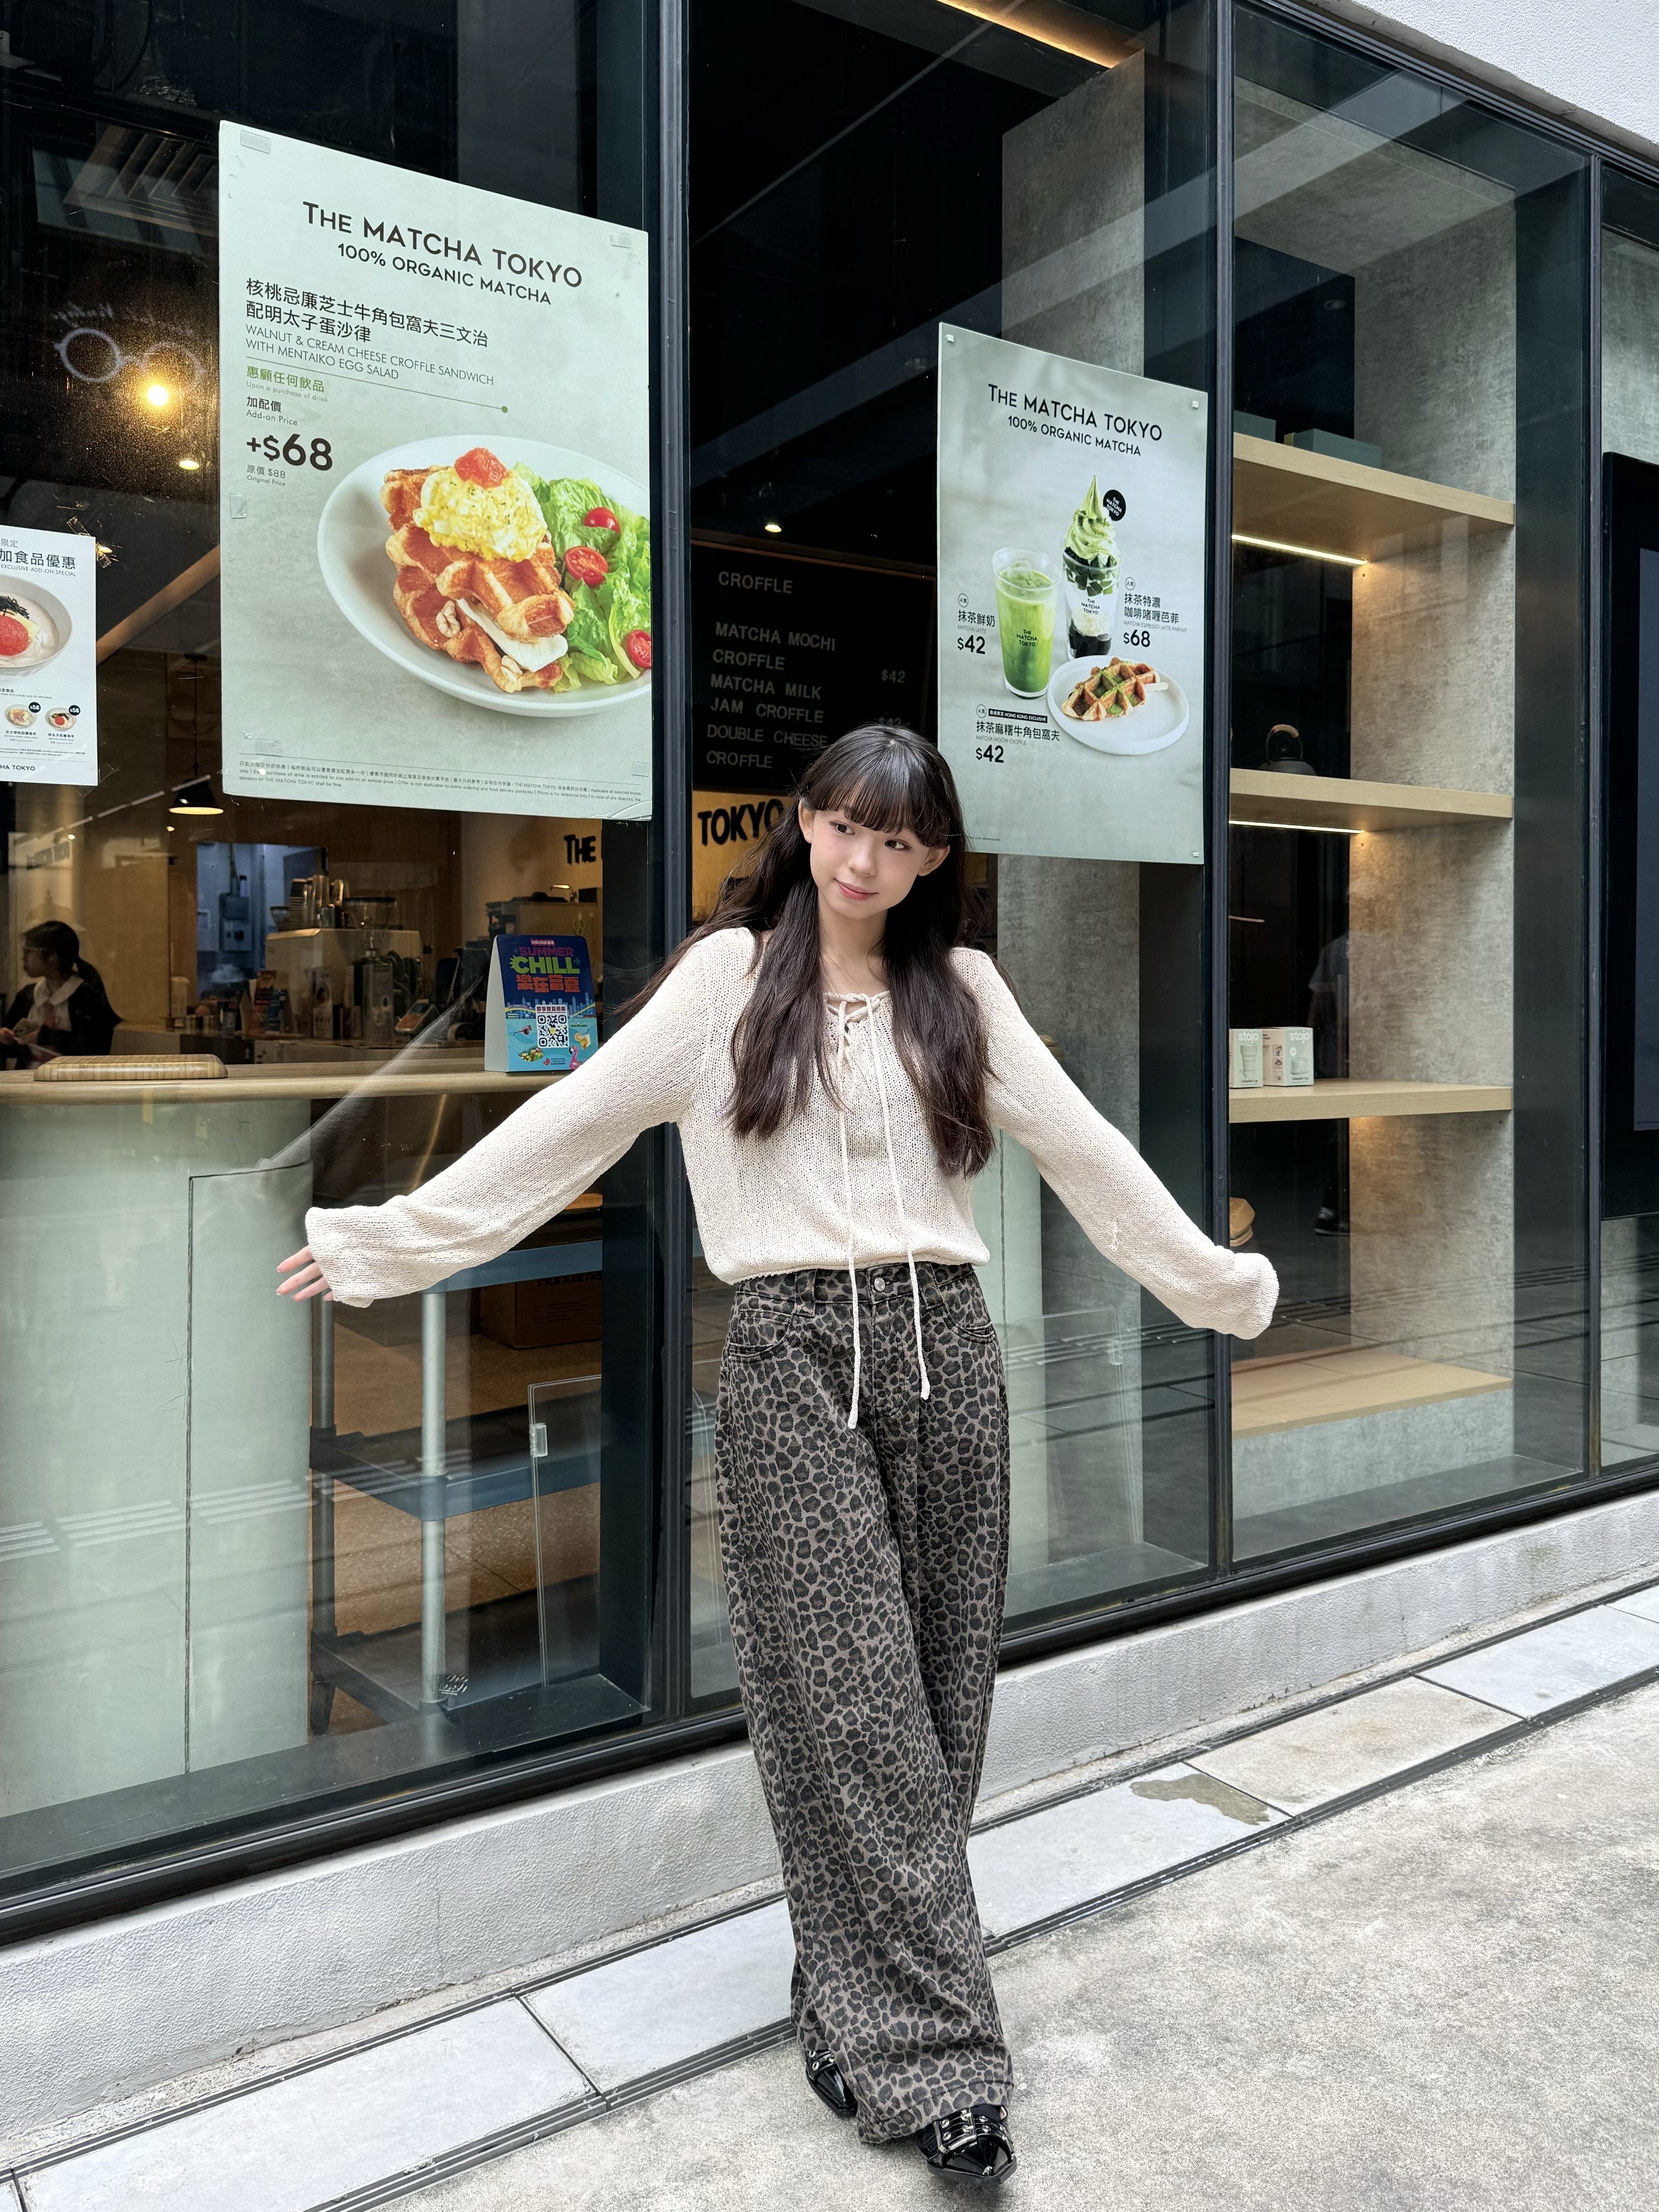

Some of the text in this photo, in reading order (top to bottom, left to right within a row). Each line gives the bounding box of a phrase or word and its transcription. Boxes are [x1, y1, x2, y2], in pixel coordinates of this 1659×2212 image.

[303, 201, 582, 287] THE MATCHA TOKYO
[338, 243, 551, 305] 100% ORGANIC MATCHA
[246, 278, 488, 347] 核桃忌廉芝士牛角包窩夫三文治
[246, 300, 371, 343] 配明太子蛋沙律
[246, 324, 493, 385] WALNUT & CREAM CHEESE CROFFLE SANDWICH
[246, 338, 398, 379] WITH MENTAIKO EGG SALAD
[247, 366, 324, 392] 惠顧任何飲品
[247, 381, 264, 390] Upon
[273, 388, 301, 398] purchase
[313, 394, 328, 403] drink
[247, 396, 281, 413] 加配價
[988, 384, 1162, 441] THE MATCHA TOKYO
[247, 410, 298, 425] Add-on Price
[1008, 415, 1141, 456] 100% ORGANIC MATCHA
[247, 433, 333, 471] +$68
[247, 465, 286, 479] 原價 $88
[247, 475, 270, 484] Original
[1106, 498, 1122, 513] MATCHA
[1106, 504, 1119, 516] TOKYO
[1, 538, 18, 548] 限定
[0, 548, 75, 569] 加食品優惠
[718, 571, 793, 594] CROFFLE
[1125, 592, 1161, 608] 抹茶特濃
[958, 609, 995, 627] 抹茶鮮奶
[1124, 606, 1179, 624] 咖啡啫喱芭菲
[715, 622, 835, 651] MATCHA MOCHI
[958, 635, 985, 654] $42
[1124, 630, 1150, 647] $68
[713, 649, 785, 670] CROFFLE
[881, 669, 905, 683] $42
[711, 674, 822, 700] MATCHA MILK
[711, 698, 824, 723] JAM CROFFLE
[707, 724, 828, 747] DOUBLE CHEESE
[976, 720, 1060, 741] 抹茶麻糬牛角包窩夫
[707, 751, 773, 769] CROFFLE
[976, 745, 1004, 763] $42
[698, 799, 784, 846] TOKYO
[564, 834, 596, 864] THE
[519, 947, 574, 956] SUMMER
[510, 956, 580, 974] CHILL
[517, 974, 580, 993] 樂在當夏
[1238, 1030, 1259, 1043] stojo
[1290, 1030, 1310, 1044] stojo
